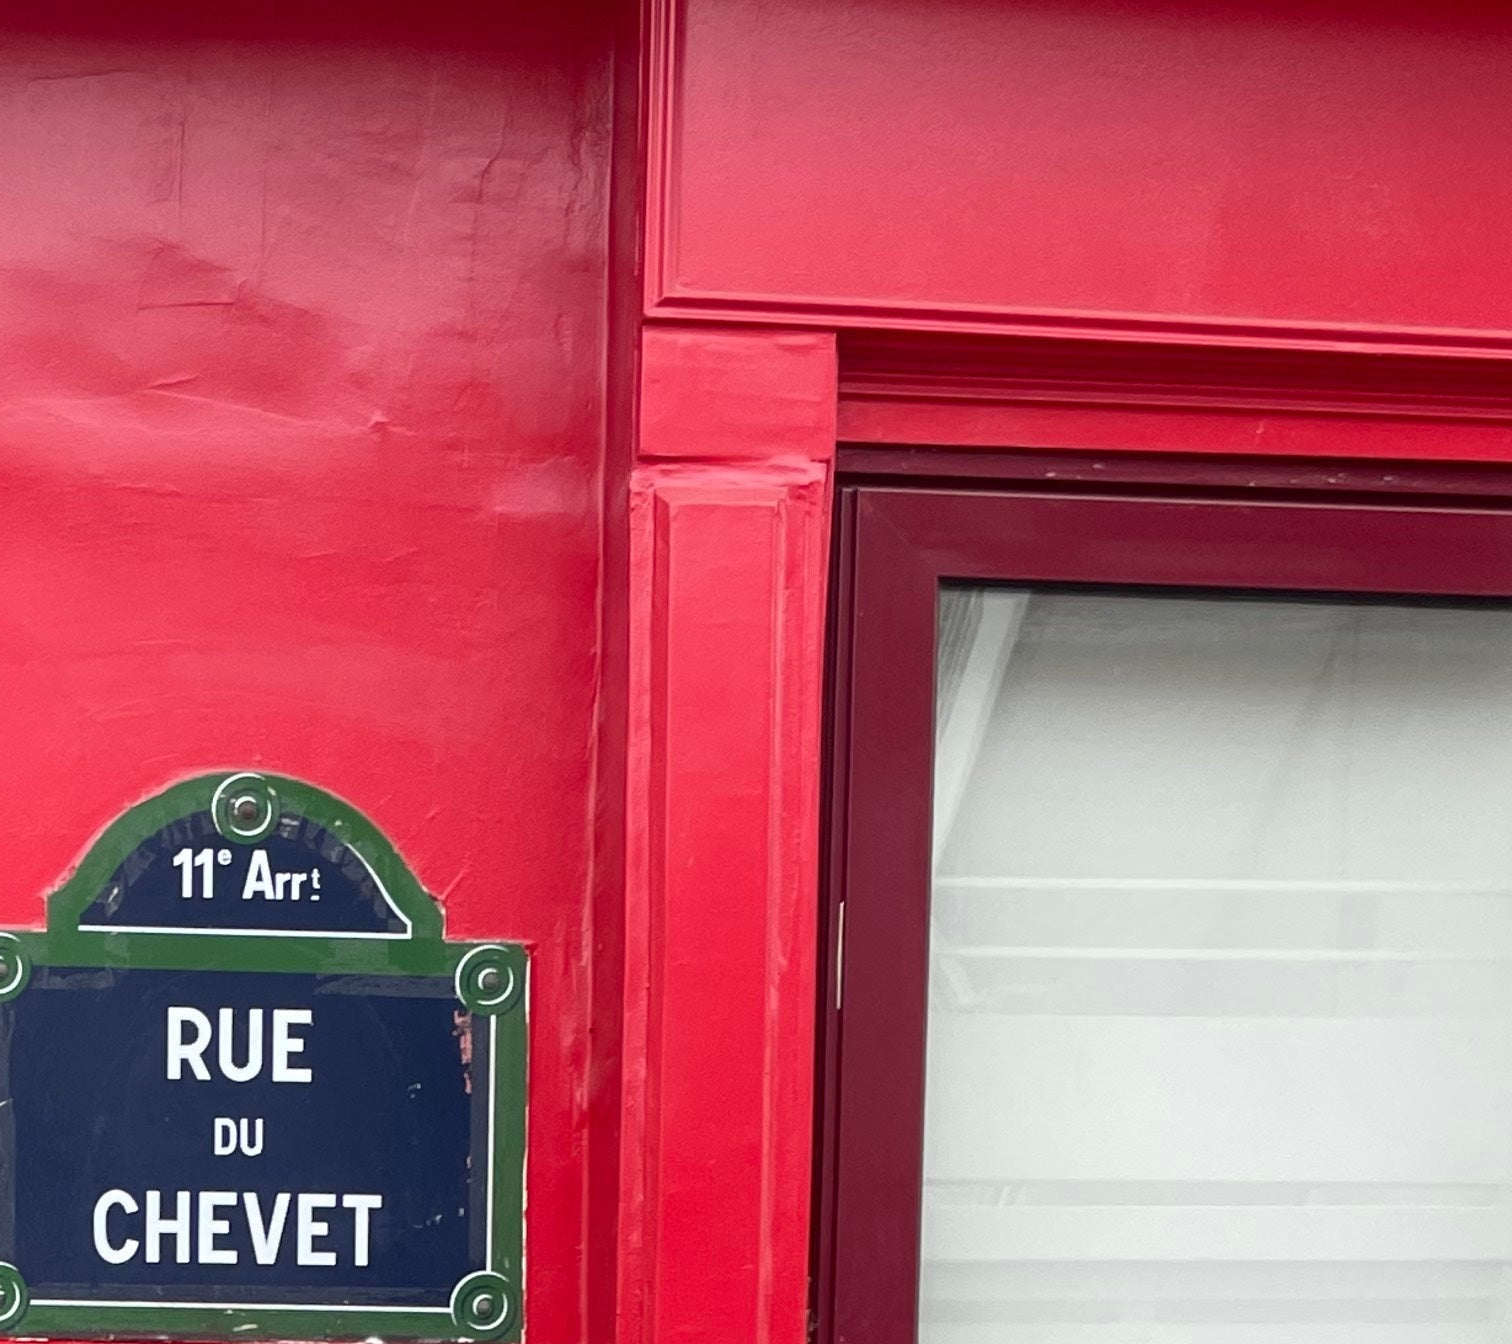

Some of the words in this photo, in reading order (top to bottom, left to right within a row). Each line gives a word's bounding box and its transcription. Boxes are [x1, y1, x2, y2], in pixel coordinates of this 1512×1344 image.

[167, 1006, 314, 1083] RUE
[214, 1117, 264, 1157] DU
[93, 1189, 383, 1267] CHEVET
